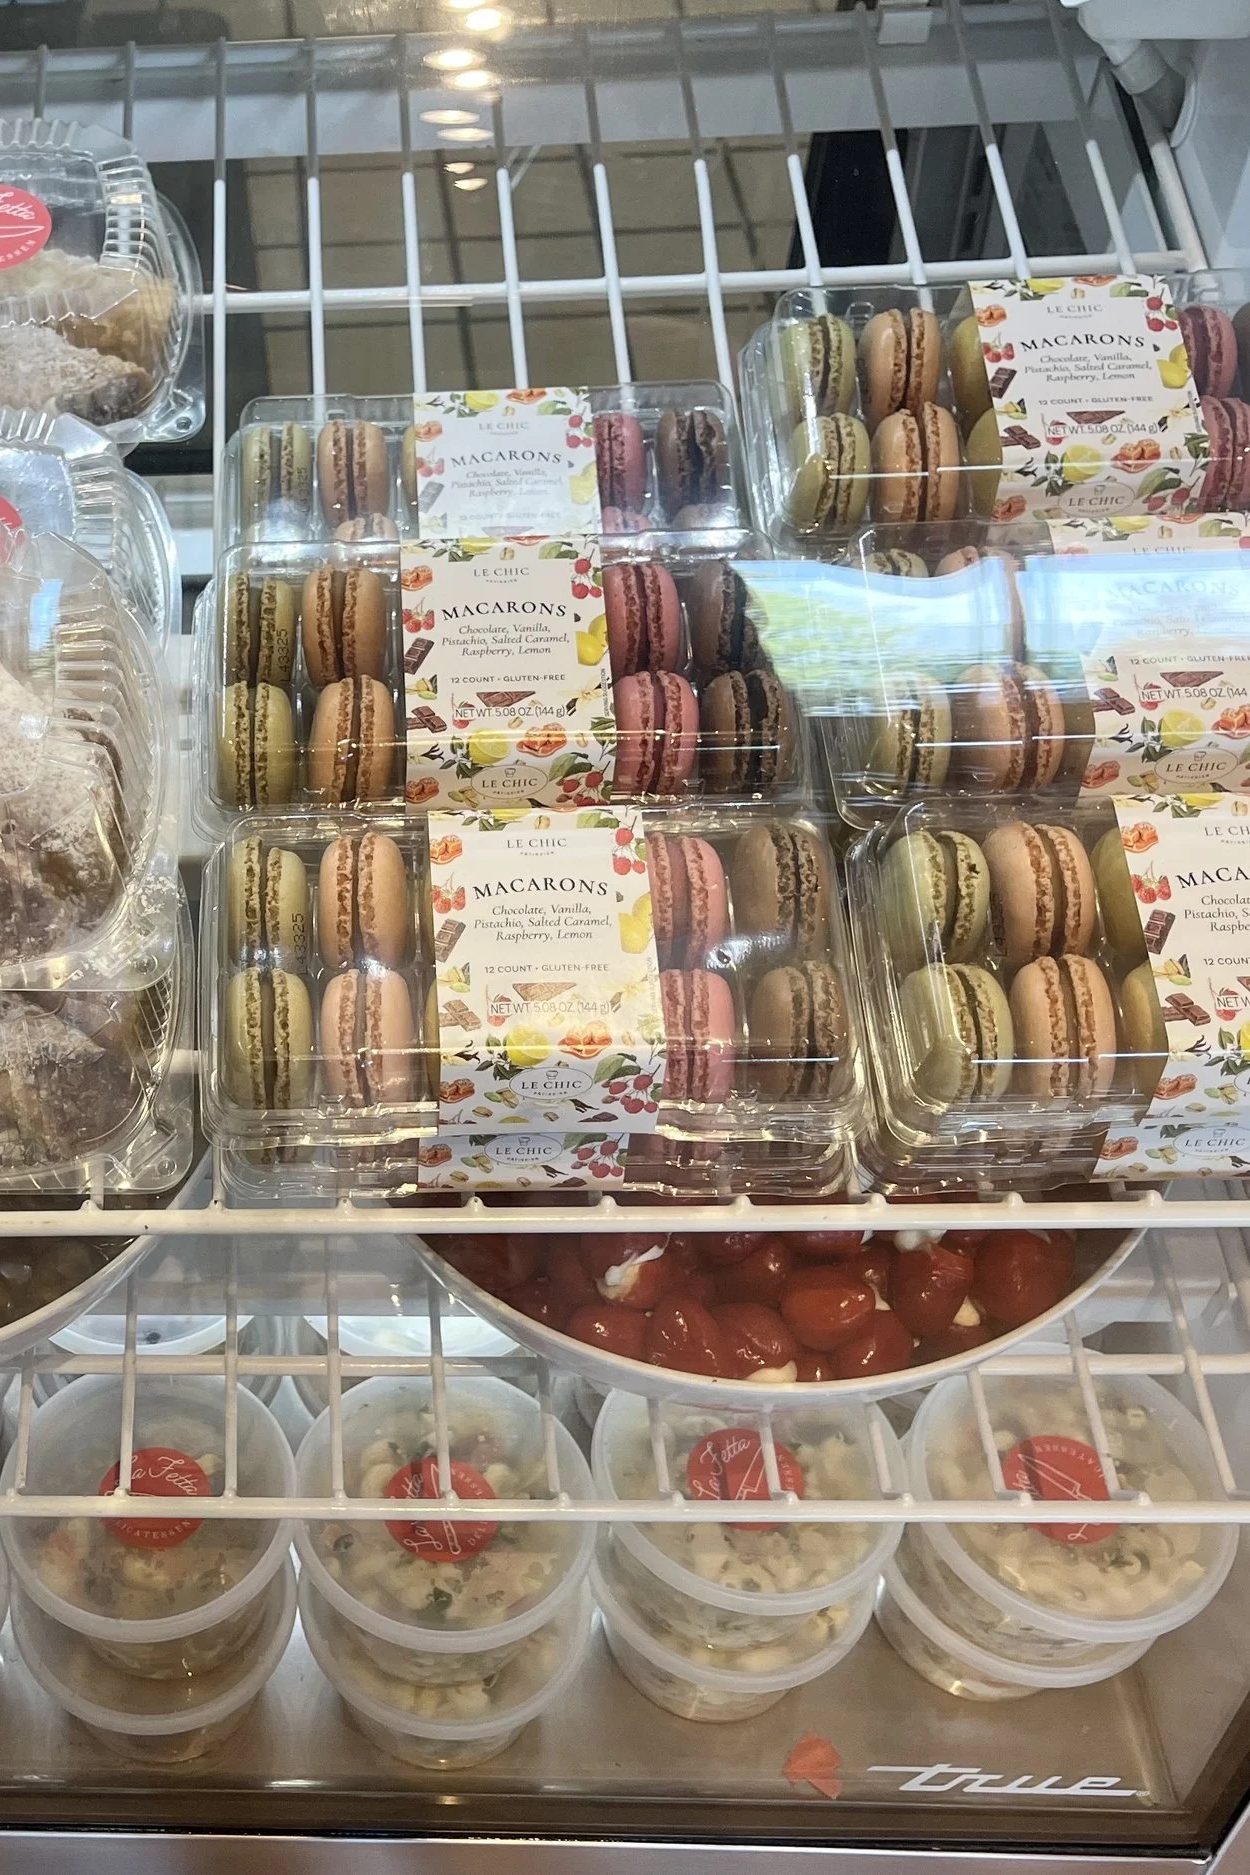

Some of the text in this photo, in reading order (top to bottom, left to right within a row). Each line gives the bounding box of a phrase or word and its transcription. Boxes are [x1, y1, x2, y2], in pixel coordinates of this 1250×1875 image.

[1046, 304, 1103, 314] LE CHIC
[1020, 333, 1146, 353] MACARONS
[1040, 352, 1133, 364] Chocolate, Vanilla,
[1107, 361, 1152, 372] Caramel,
[1102, 371, 1136, 381] Lemon
[1050, 397, 1083, 405] COUNT
[1047, 426, 1068, 436] NET
[450, 449, 563, 468] MACARONS
[1068, 496, 1126, 506] LE CHIC
[473, 567, 530, 577] LE CHIC
[441, 601, 567, 621] MACARONS
[458, 623, 551, 636] Chocolate, Vanilla,
[441, 633, 570, 647] Pistachio, Salted Caramel,
[461, 645, 552, 658] Raspberry, Lemon
[1143, 656, 1179, 664] COUNT
[502, 674, 566, 682] GLUTEN-FREE
[1141, 690, 1163, 700] NET
[1185, 688, 1208, 698] 5.08
[1228, 687, 1248, 698] (144
[455, 709, 474, 718] NET
[495, 707, 517, 717] 5.08
[535, 705, 554, 718] (144
[1166, 762, 1227, 772] LE CHIC
[482, 778, 539, 788] LE CHIC
[1204, 825, 1250, 837] LE CH
[507, 838, 567, 849] LE CHIC
[1175, 865, 1250, 889] MACA
[472, 877, 608, 900] MACARONS
[492, 903, 592, 917] Chocolate, Vanilla,
[1184, 908, 1238, 919] Pistachio,
[473, 915, 613, 930] Pistachio, Salted Caramel,
[496, 928, 593, 944] Raspberry, Lemon
[1203, 958, 1215, 966] 12
[484, 963, 610, 974] 12 COUNT GLUTEN-FREE
[490, 1002, 511, 1014] NET
[533, 1001, 557, 1013] 5.08
[1216, 996, 1239, 1008] NET
[521, 1081, 582, 1090] LE CHIC
[1185, 1138, 1246, 1147] LE CHIC
[495, 1146, 552, 1155] LE CHIC
[700, 1436, 750, 1476] Fetta
[148, 1456, 199, 1496] Fetta
[867, 1764, 1137, 1797] true
